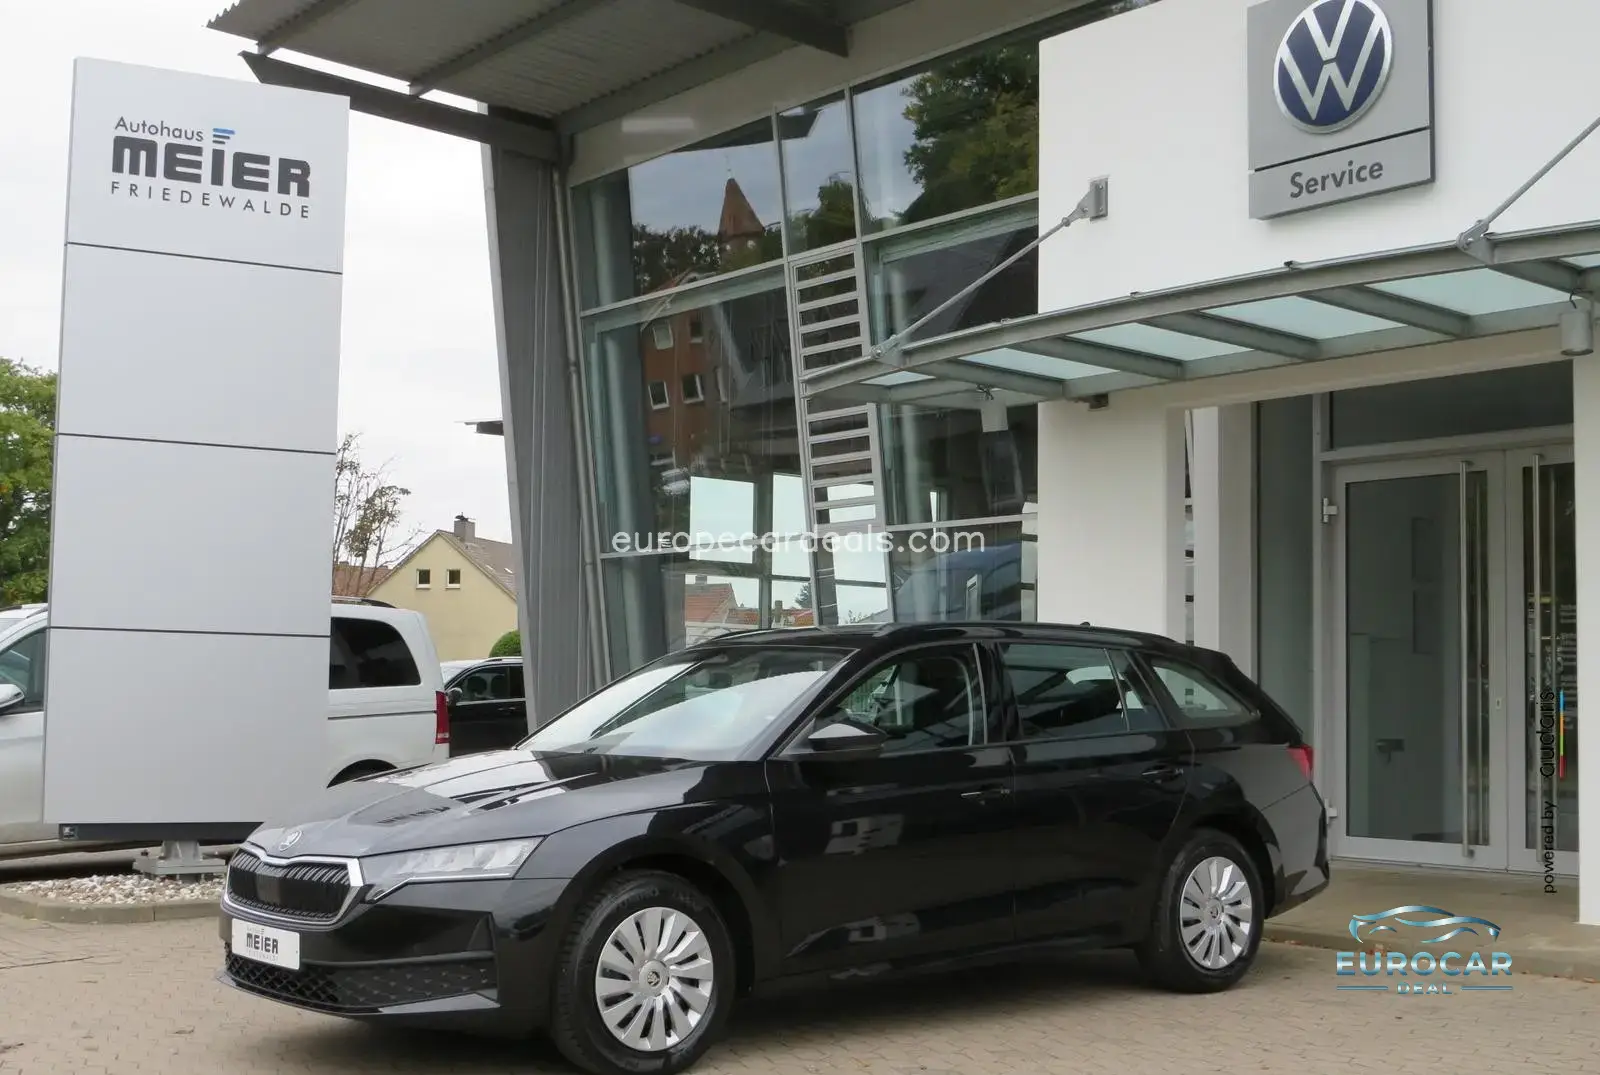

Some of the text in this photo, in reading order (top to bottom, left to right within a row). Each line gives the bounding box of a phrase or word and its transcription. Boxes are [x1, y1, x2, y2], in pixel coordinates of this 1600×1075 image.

[1277, 0, 1387, 122] VW
[114, 116, 204, 142] Autohaus
[111, 135, 311, 198] MEIER
[1290, 160, 1384, 199] Service
[111, 181, 309, 219] FRIEDEWALDE
[246, 932, 279, 954] MEIER
